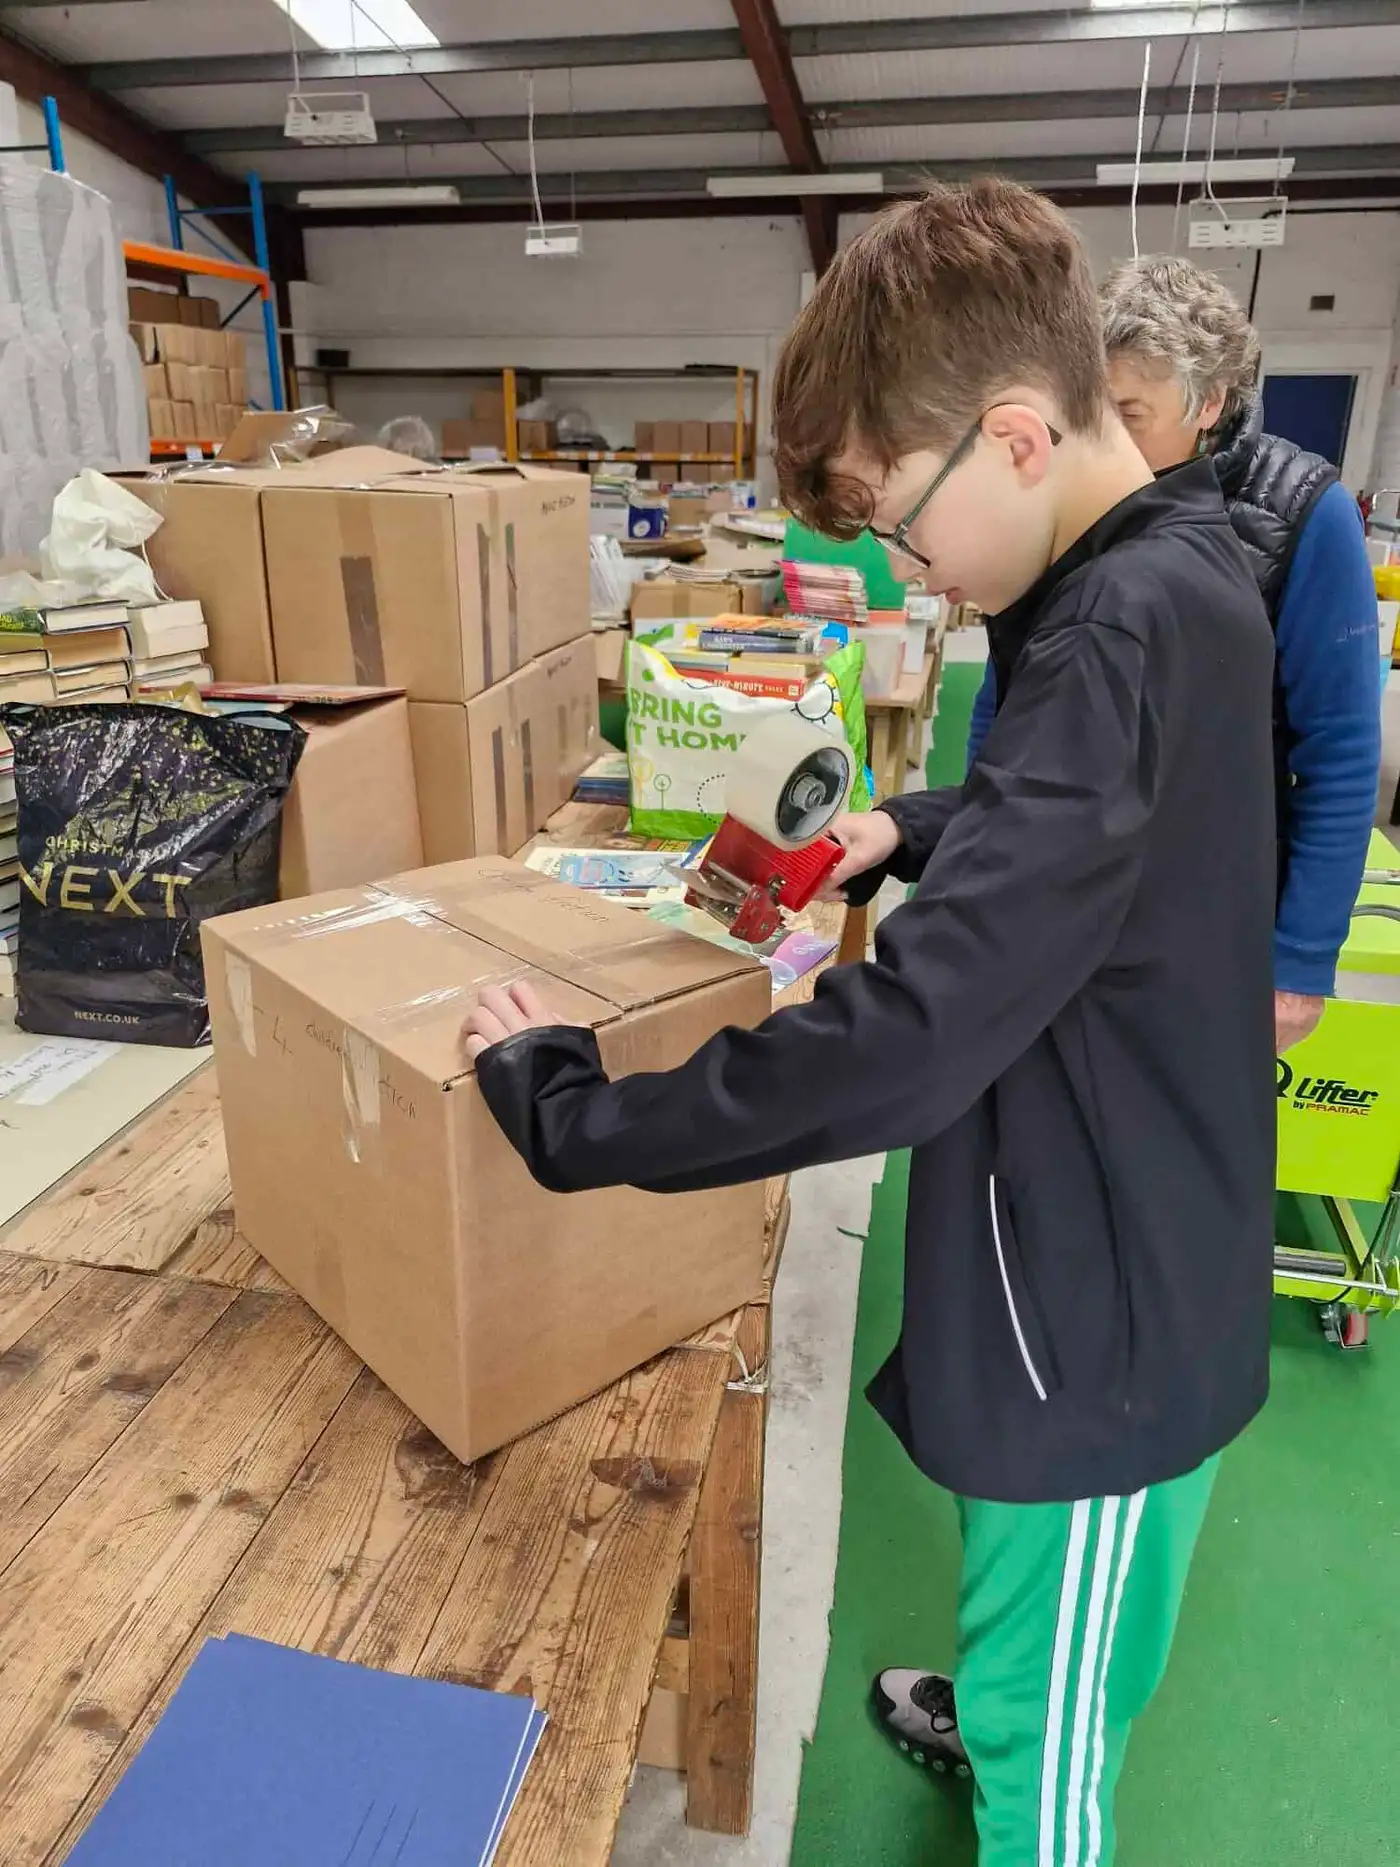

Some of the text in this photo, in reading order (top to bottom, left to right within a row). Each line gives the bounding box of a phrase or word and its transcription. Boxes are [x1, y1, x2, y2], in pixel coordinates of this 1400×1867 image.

[631, 688, 722, 728] BRING
[656, 725, 748, 752] HOM
[18, 861, 193, 919] NEXT
[74, 1011, 140, 1024] NEXT.CO.UK
[1295, 1078, 1379, 1108] Lifter
[1293, 1101, 1372, 1116] by PRAMAC
